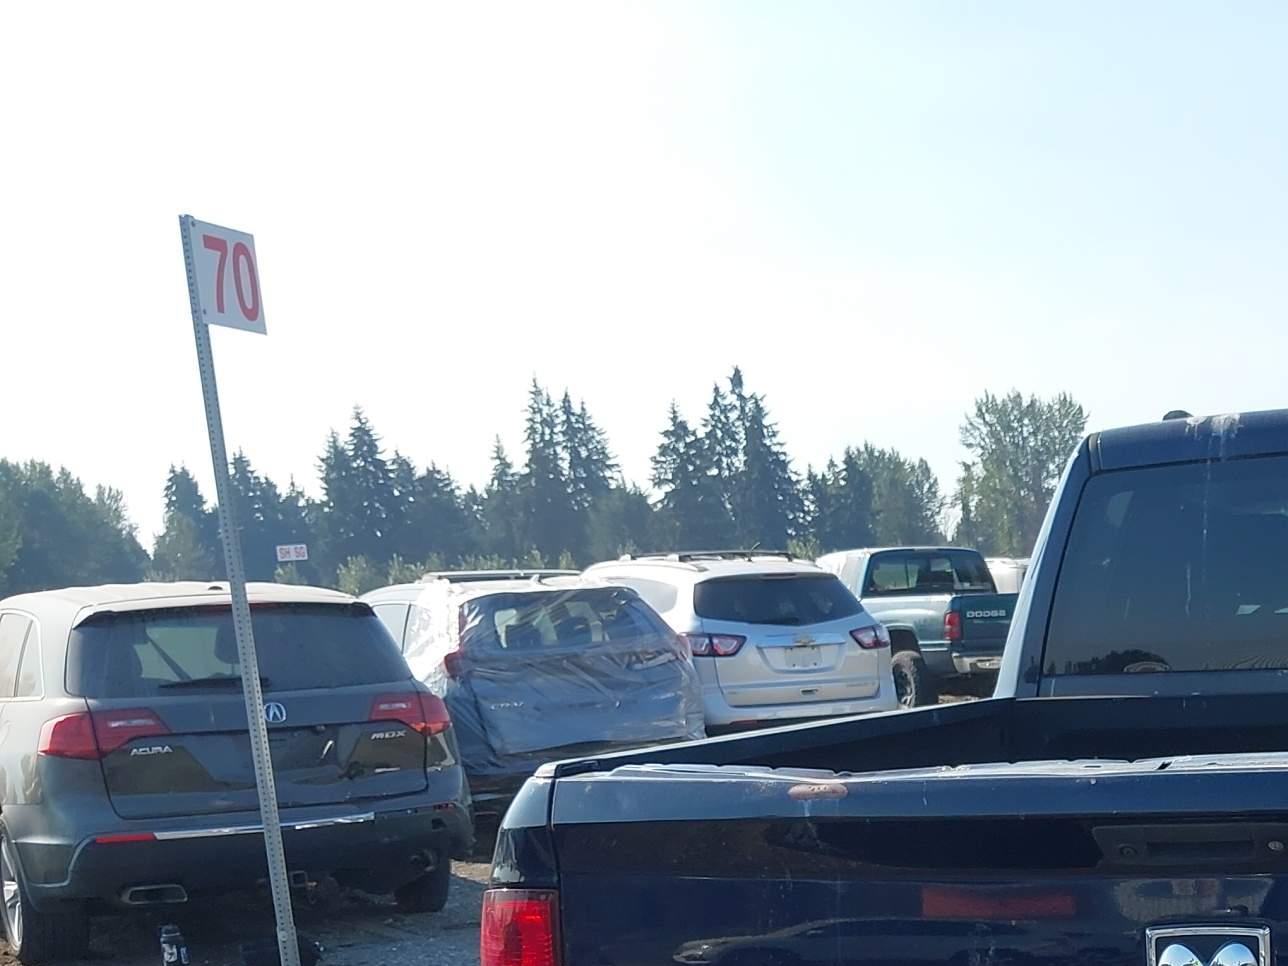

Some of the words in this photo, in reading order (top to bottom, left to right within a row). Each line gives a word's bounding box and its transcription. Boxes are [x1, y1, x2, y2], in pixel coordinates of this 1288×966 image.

[202, 234, 260, 322] 70
[966, 610, 1006, 618] DODGE
[371, 730, 406, 740] MDX
[130, 745, 173, 756] ACURA
